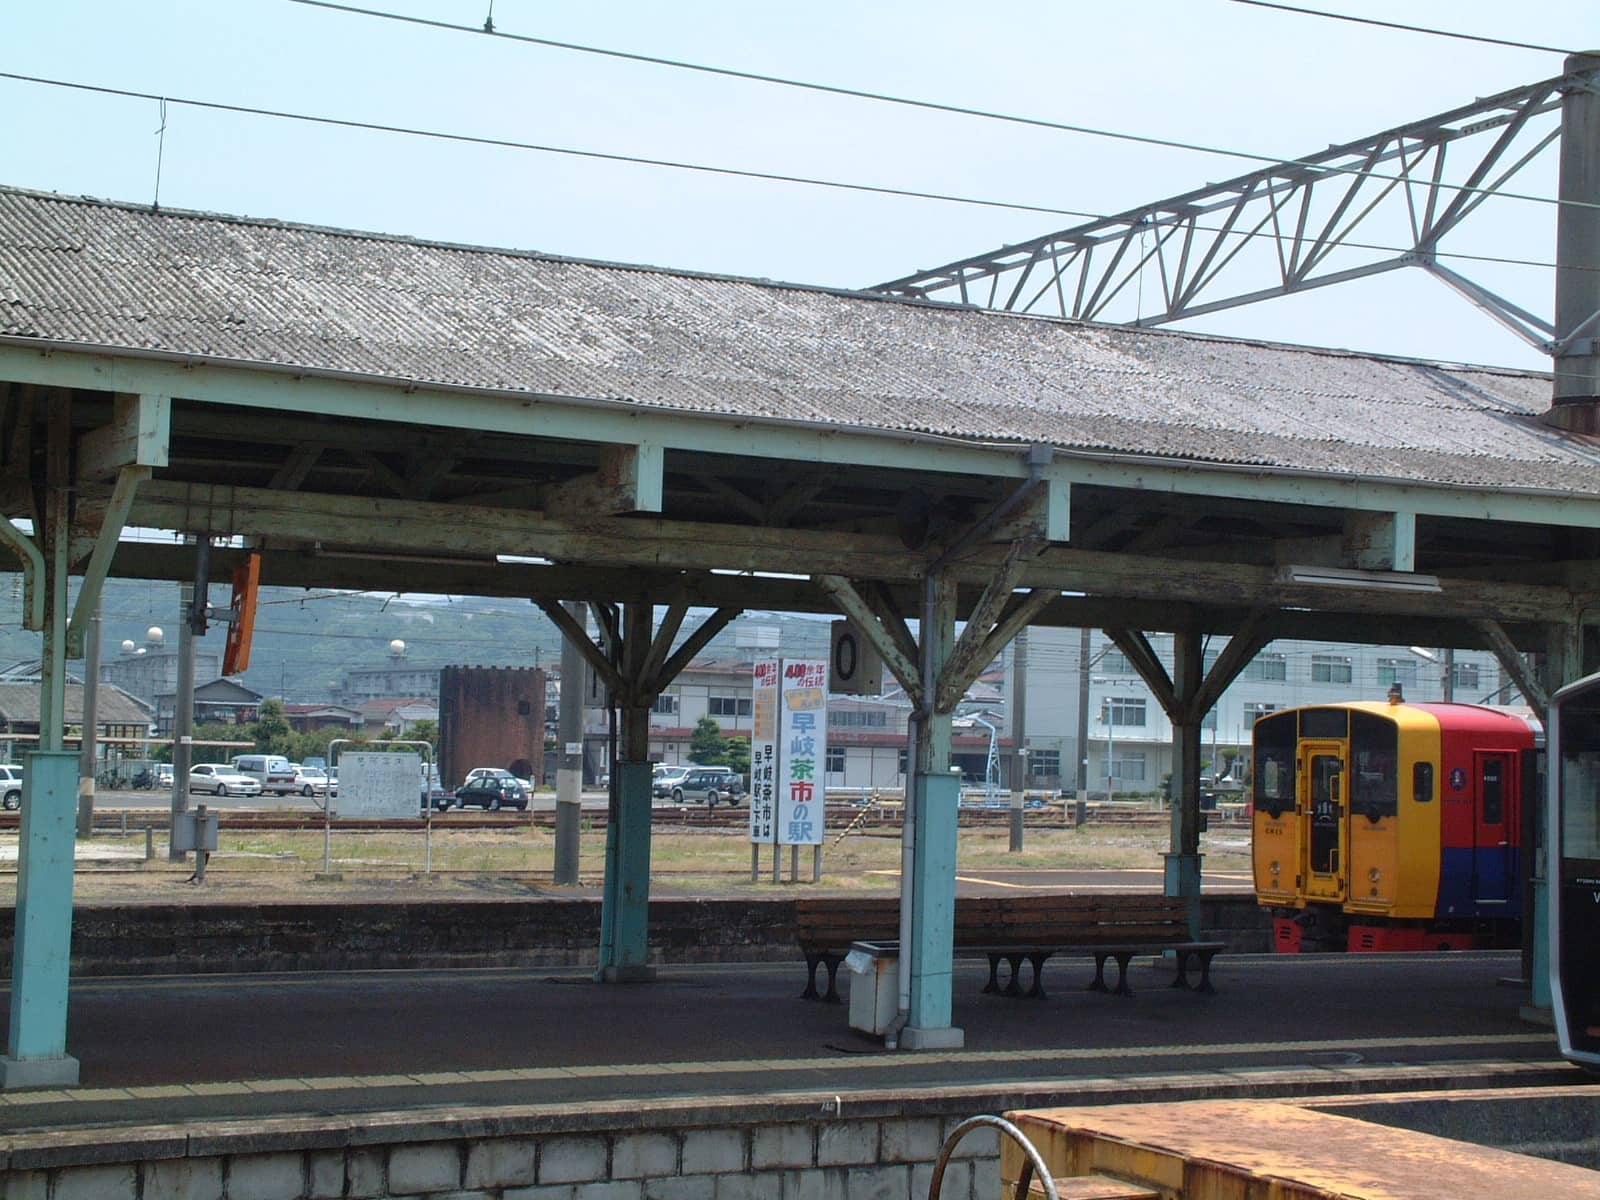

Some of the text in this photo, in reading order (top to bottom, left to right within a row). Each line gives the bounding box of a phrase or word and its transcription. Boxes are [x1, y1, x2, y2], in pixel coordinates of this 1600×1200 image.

[753, 751, 762, 837] 早岐駅で下車
[762, 744, 773, 838] 早岐茶市は
[789, 713, 816, 842] 早岐茶市の駅
